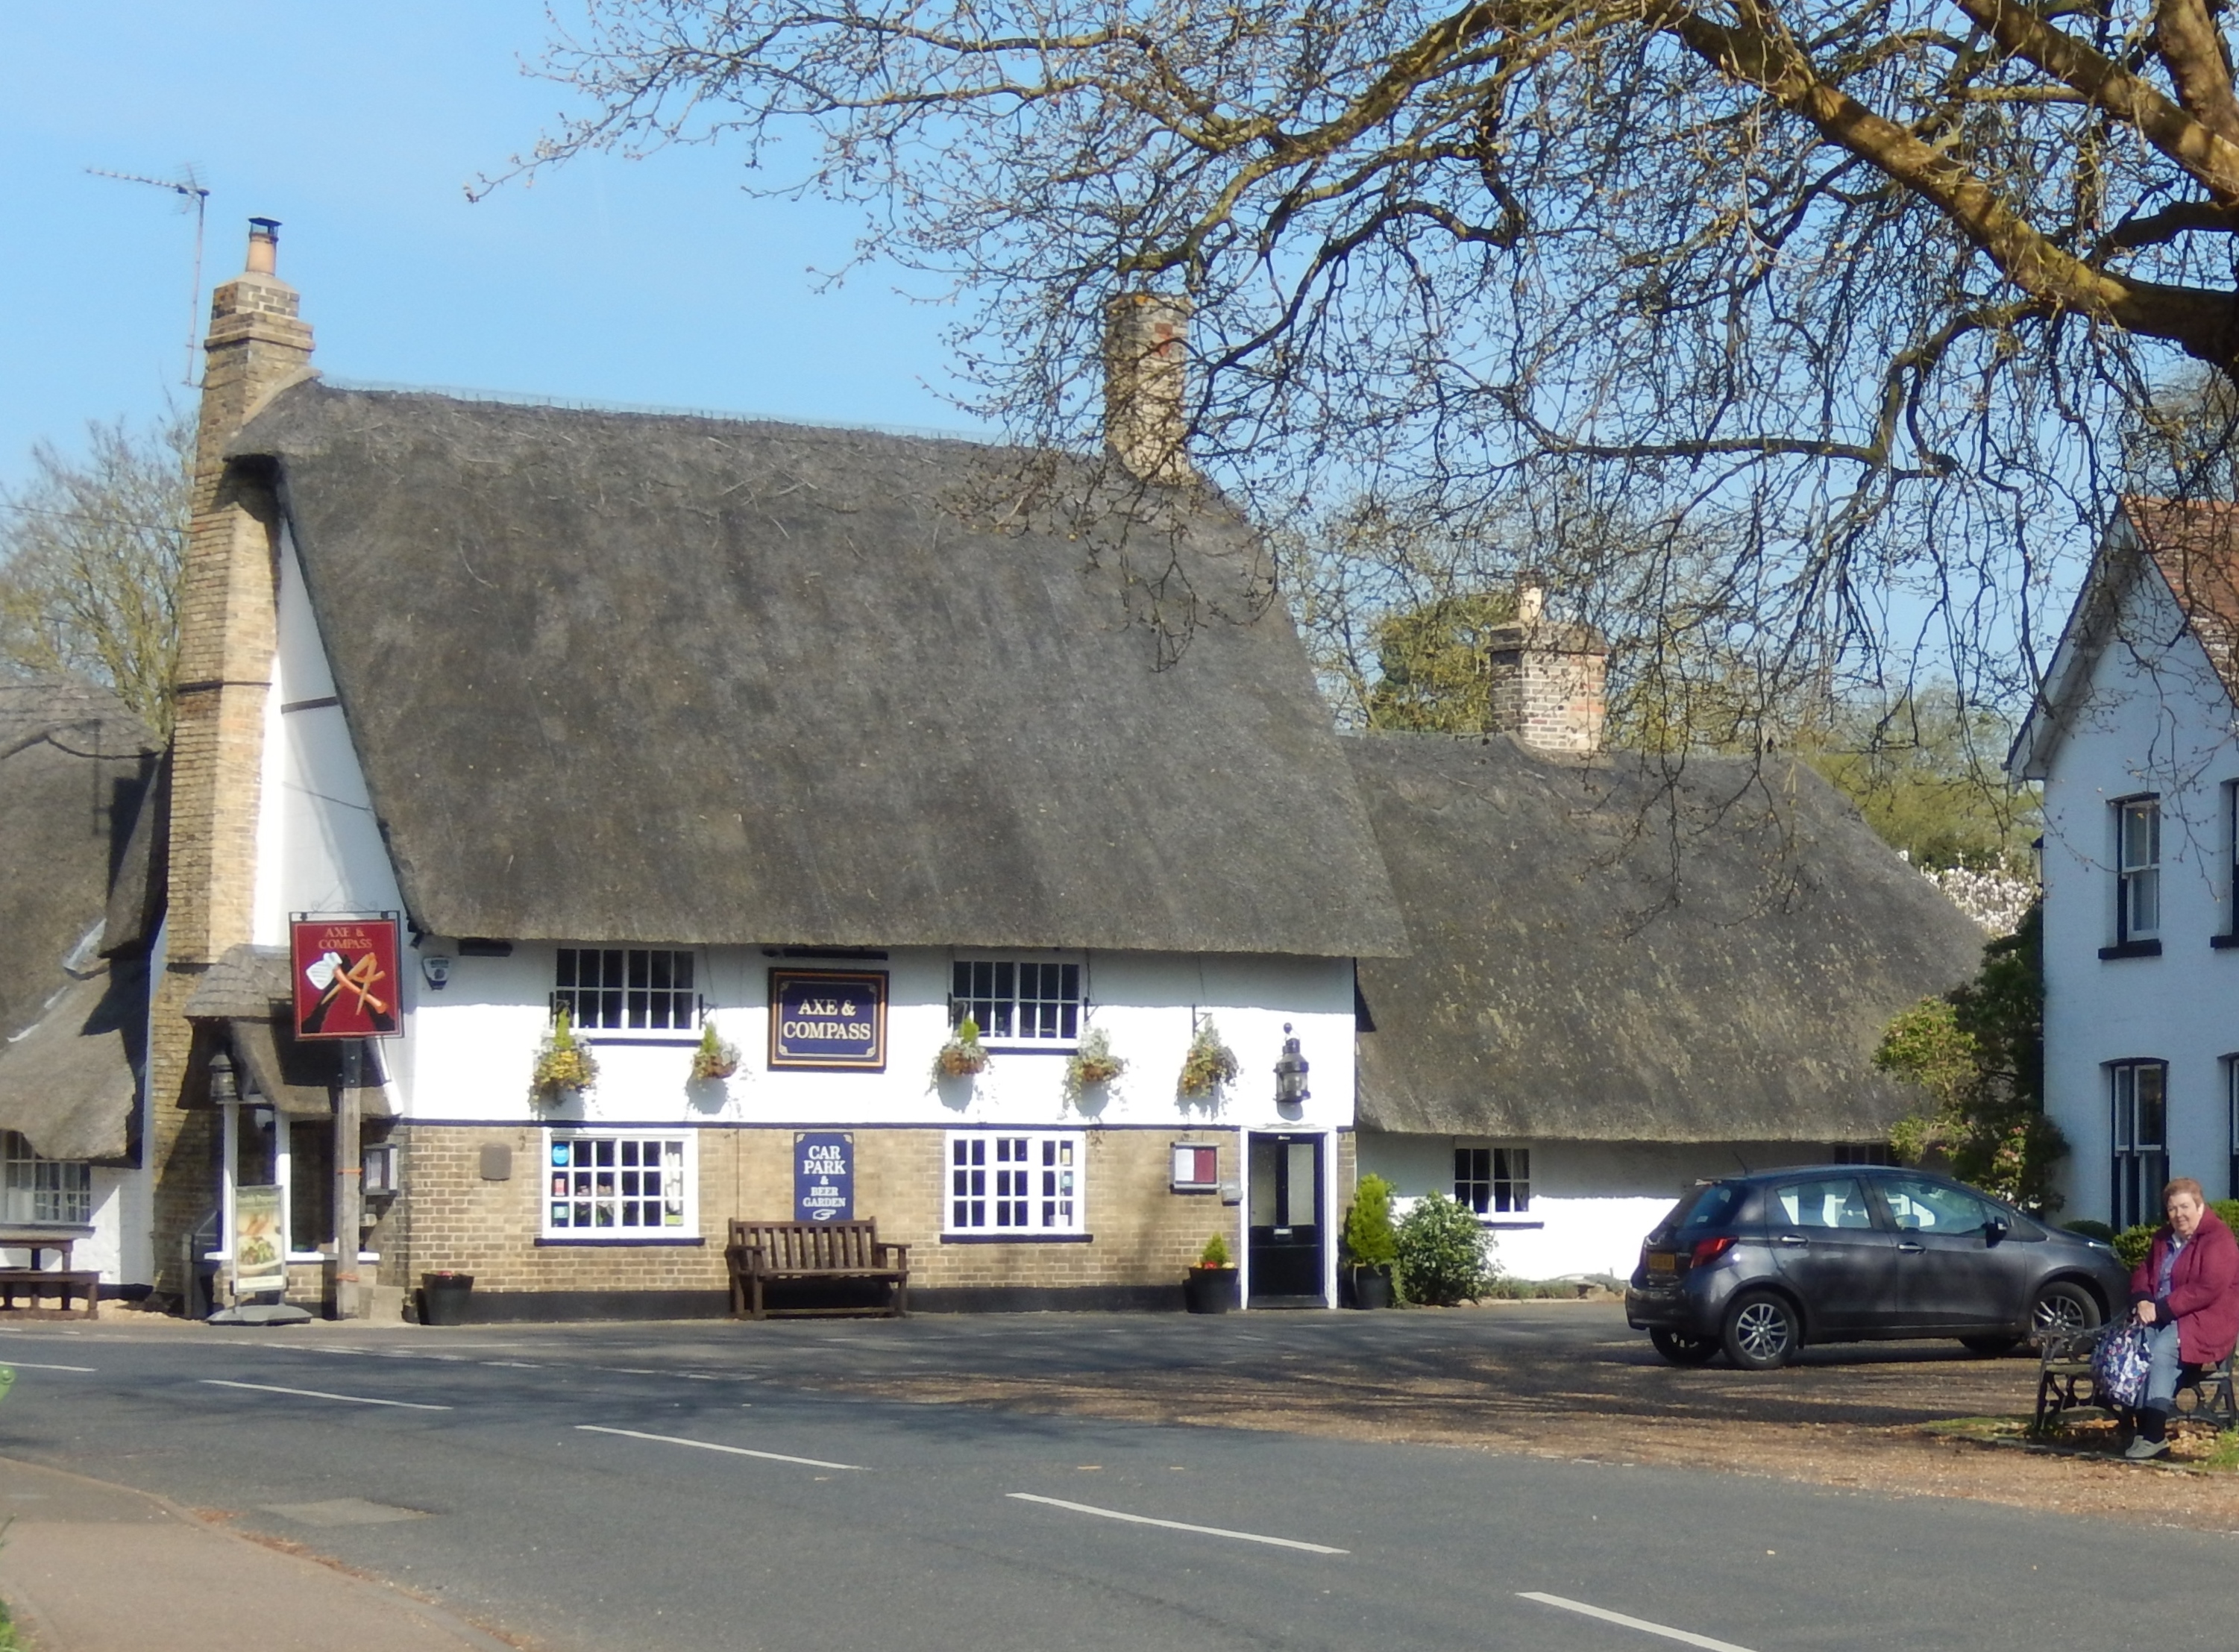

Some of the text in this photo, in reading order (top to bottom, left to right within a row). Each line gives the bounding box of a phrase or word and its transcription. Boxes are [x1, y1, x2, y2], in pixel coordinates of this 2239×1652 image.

[325, 927, 365, 938] AXE &
[318, 938, 372, 949] COMPASS
[798, 999, 856, 1016] AXE &
[783, 1022, 871, 1040] COMPASS
[808, 1146, 841, 1160] CAR
[803, 1161, 846, 1174] PARK
[820, 1175, 829, 1184] &
[811, 1187, 838, 1196] BEER
[803, 1198, 846, 1207] GARDEN
